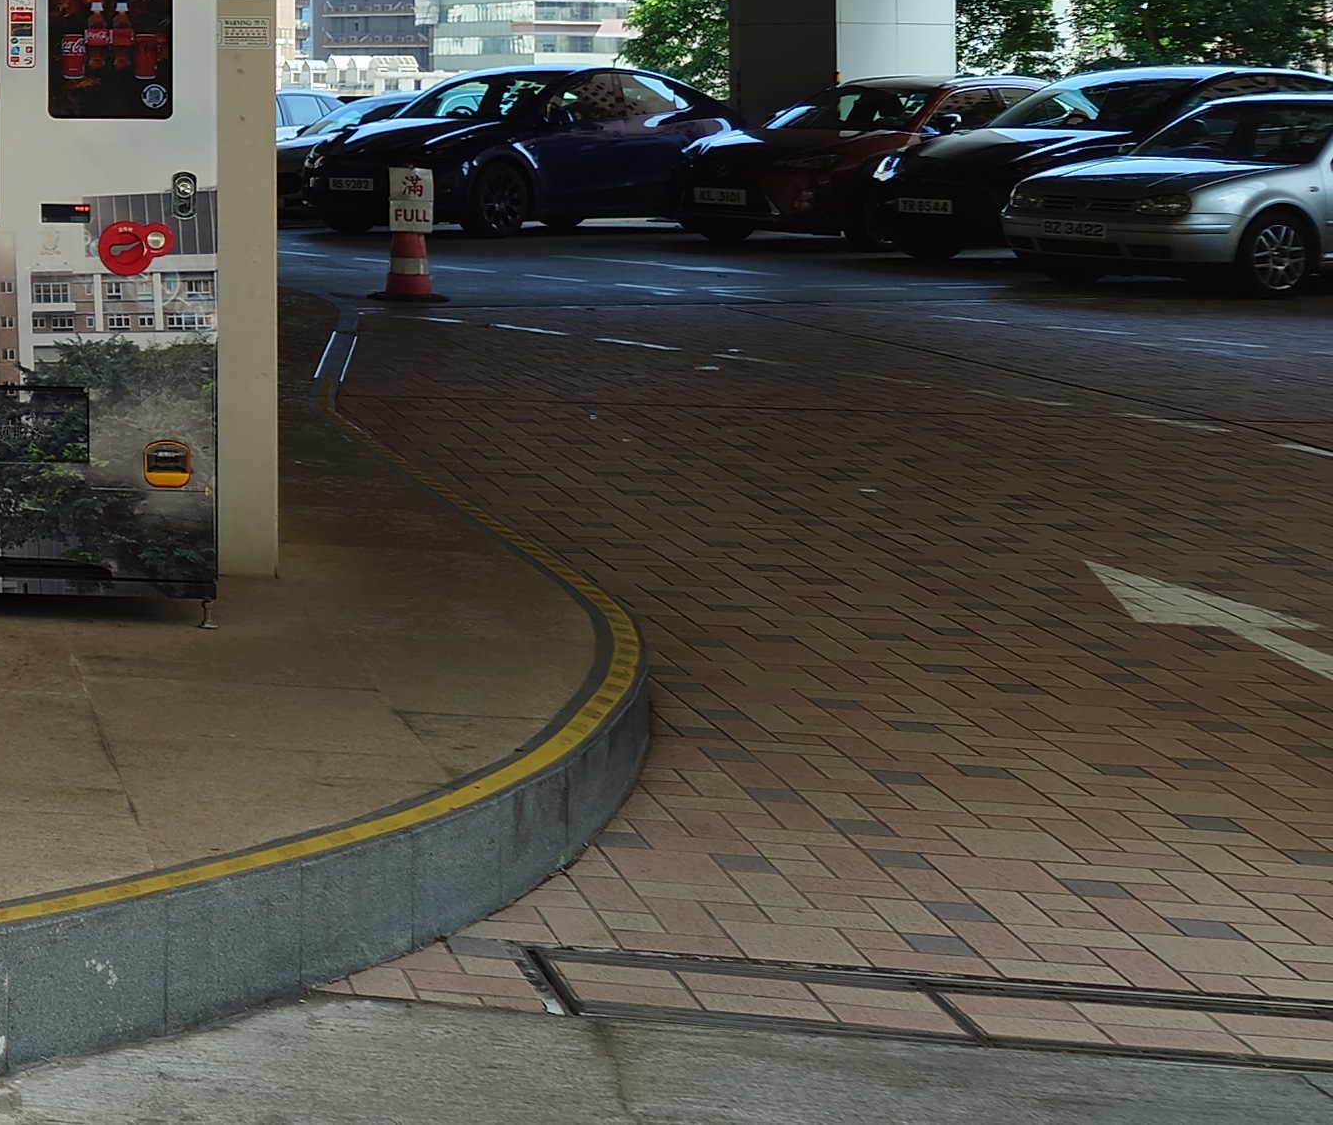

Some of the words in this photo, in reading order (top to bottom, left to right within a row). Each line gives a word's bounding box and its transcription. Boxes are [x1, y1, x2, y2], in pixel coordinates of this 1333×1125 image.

[345, 180, 369, 189] 9282
[401, 174, 424, 197] 滿
[395, 209, 430, 222] FULL
[1044, 221, 1061, 233] BZ
[1064, 222, 1104, 236] 3422
